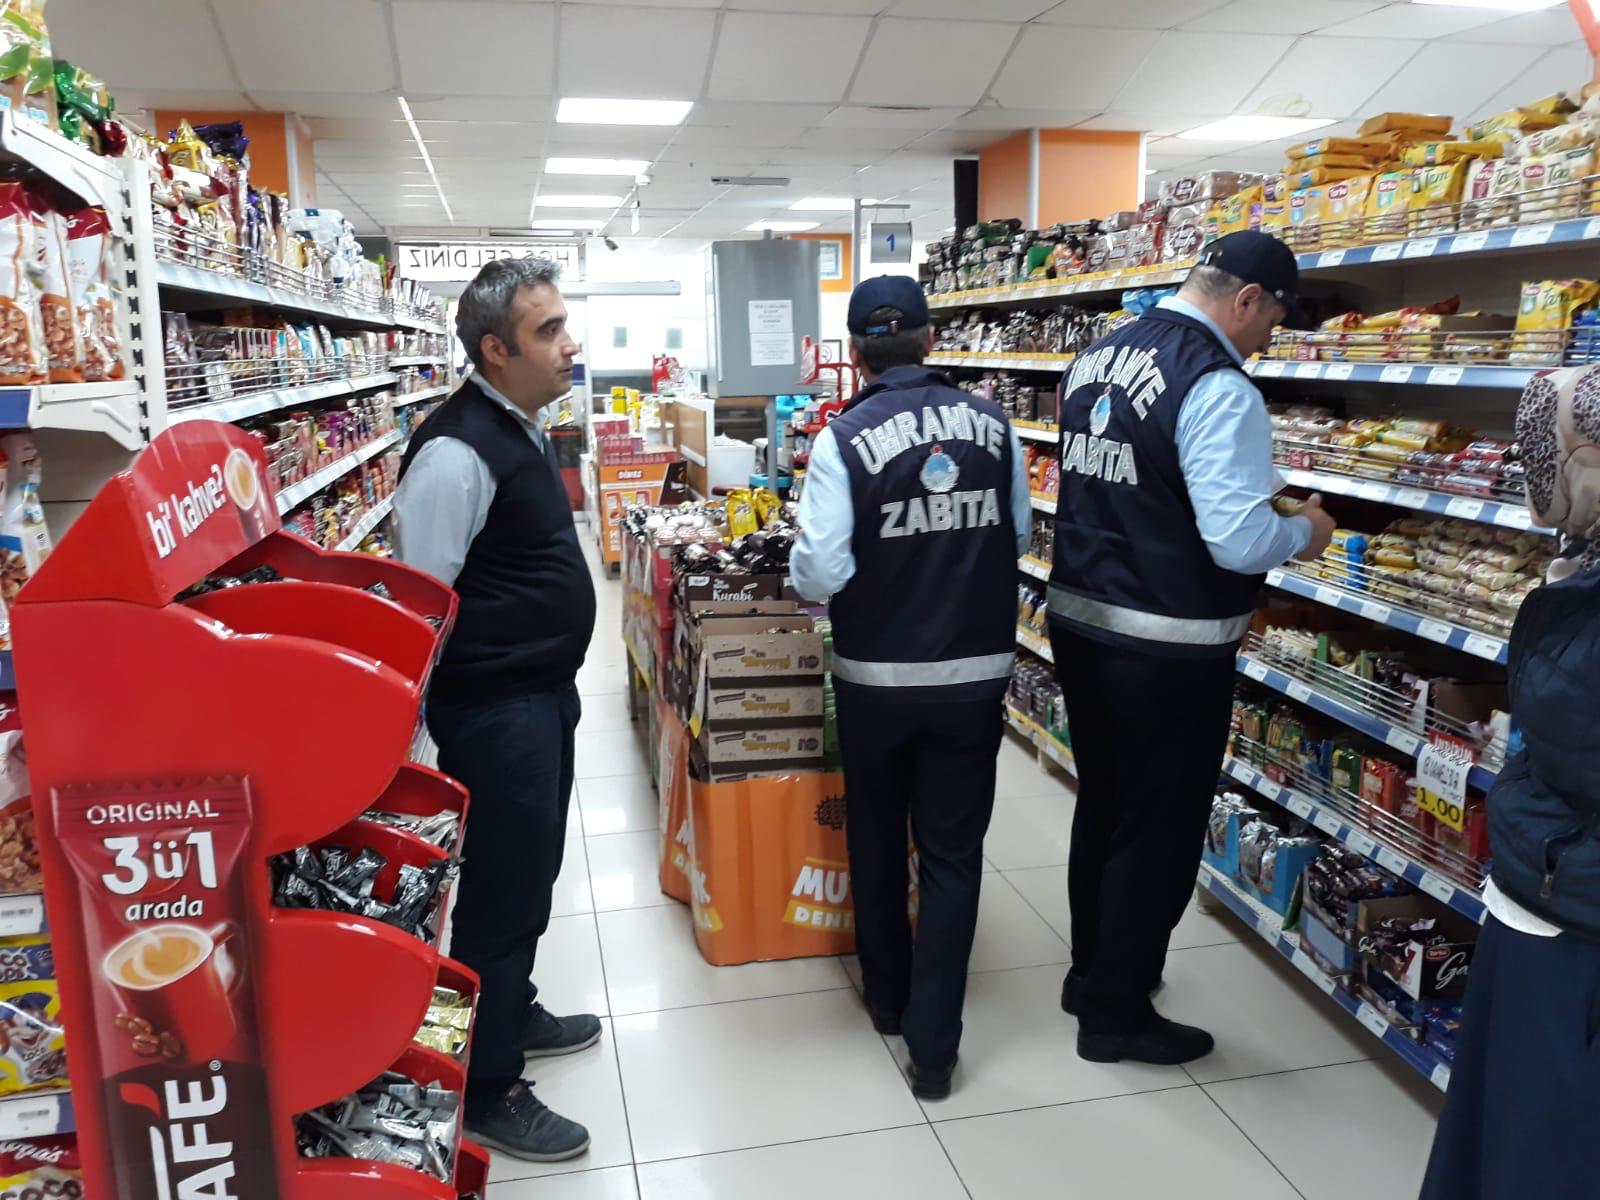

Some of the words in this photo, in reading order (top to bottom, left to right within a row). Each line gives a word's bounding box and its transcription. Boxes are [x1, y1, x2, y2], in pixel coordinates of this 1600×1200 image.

[886, 233, 896, 252] 1
[171, 463, 226, 538] kahve?
[880, 488, 1000, 538] ZABITA
[86, 799, 219, 824] ORIGINAL
[792, 865, 850, 904] MU
[125, 894, 203, 921] arada
[1435, 951, 1470, 990] Ga
